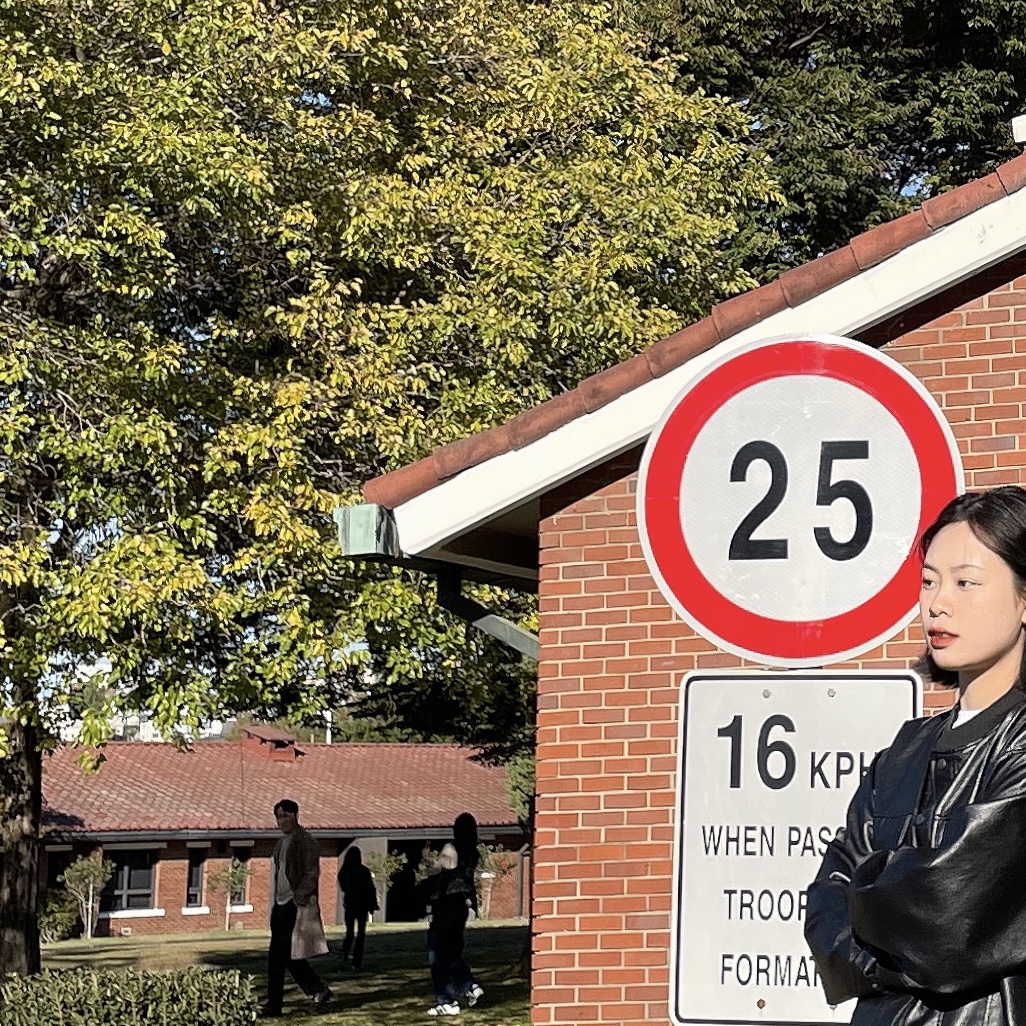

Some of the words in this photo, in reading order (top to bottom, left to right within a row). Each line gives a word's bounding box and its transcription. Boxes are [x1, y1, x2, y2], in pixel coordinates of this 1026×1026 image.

[728, 440, 873, 561] 25
[717, 714, 797, 790] 16
[702, 825, 775, 857] WHEN
[788, 825, 848, 857] PAS
